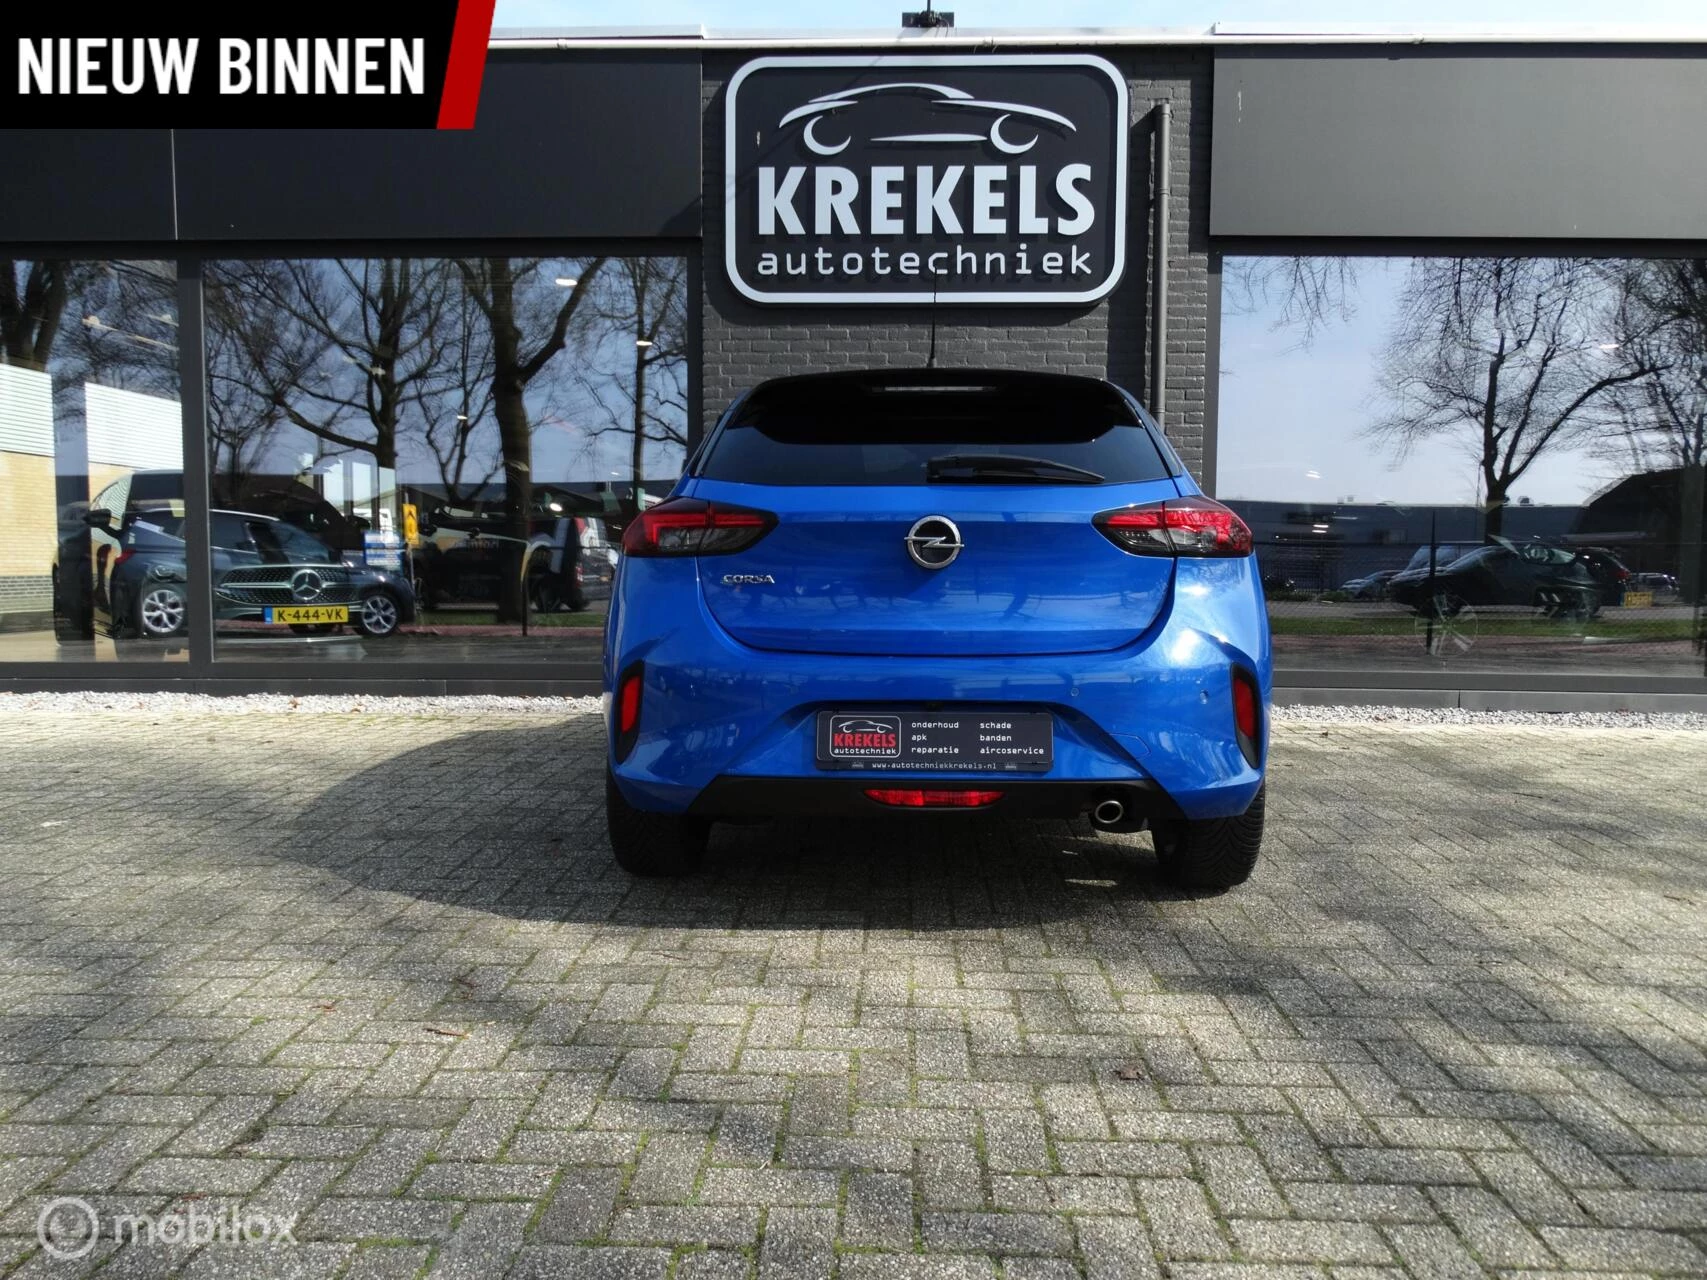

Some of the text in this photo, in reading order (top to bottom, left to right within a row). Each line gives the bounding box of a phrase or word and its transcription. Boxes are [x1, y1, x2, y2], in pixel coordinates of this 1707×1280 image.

[758, 163, 1095, 235] KREKELS
[757, 244, 1092, 276] autotechniek
[723, 574, 775, 584] CORSA
[277, 608, 343, 622] K-444-VK
[911, 721, 1012, 729] onderhoud schade
[833, 733, 897, 747] KREKELS
[911, 732, 1012, 742] apk banden
[833, 747, 897, 755] autotechniek
[911, 746, 1045, 755] reparatie aircoservice
[871, 761, 997, 770] www.autotechniekkrekels.nl
